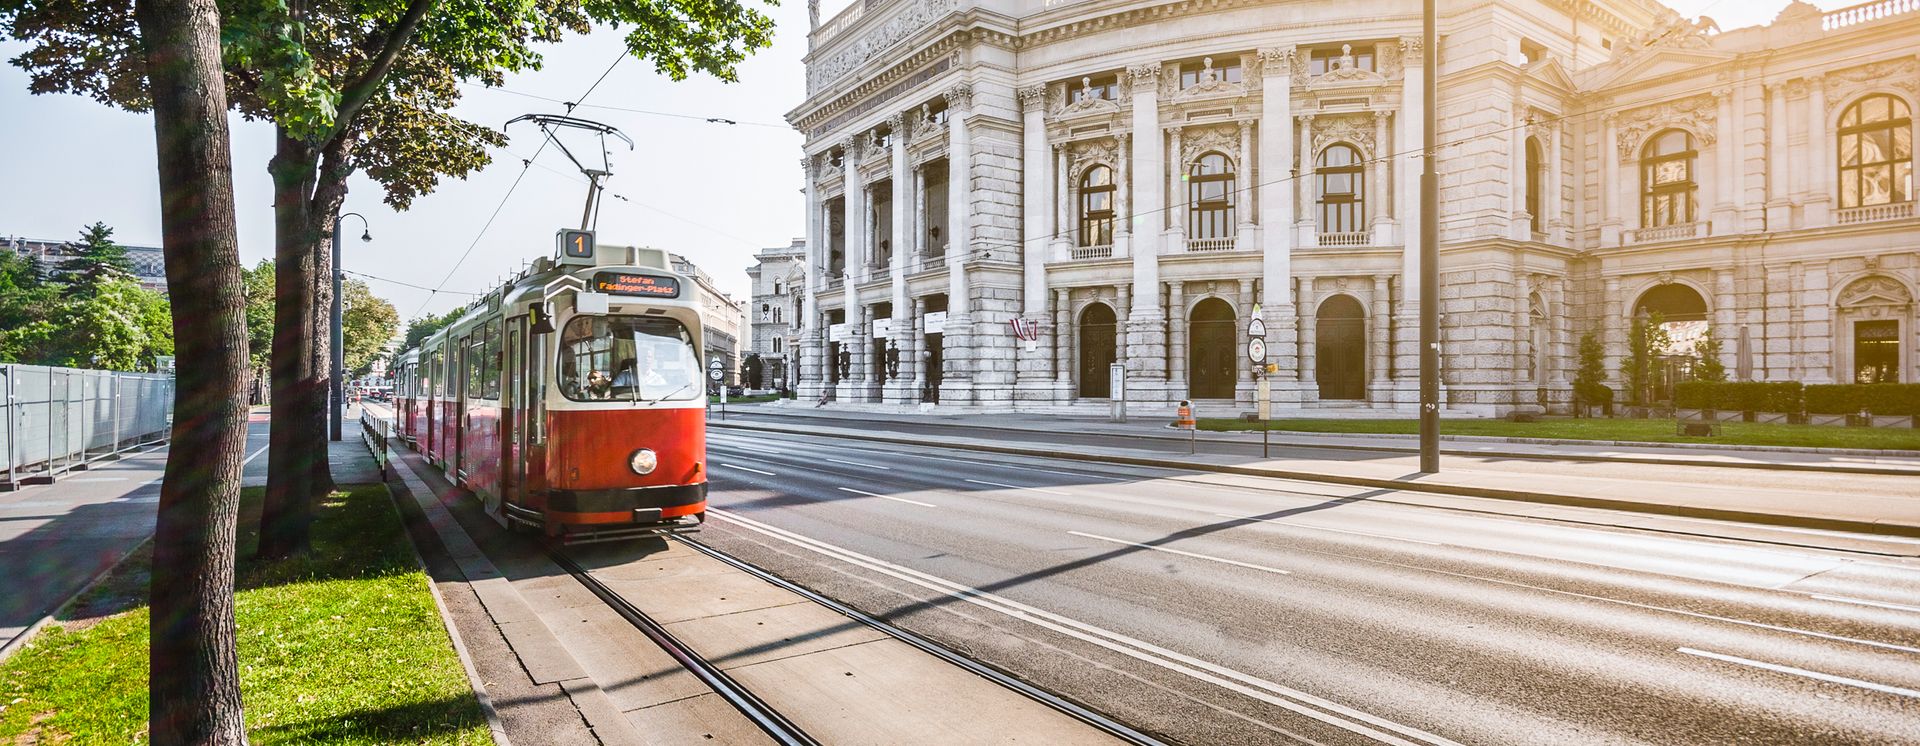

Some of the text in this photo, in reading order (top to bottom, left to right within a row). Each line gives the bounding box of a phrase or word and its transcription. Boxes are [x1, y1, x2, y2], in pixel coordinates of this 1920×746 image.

[575, 235, 584, 253] 1
[619, 276, 655, 285] Stefan
[599, 282, 674, 294] Fadinger-Platz
